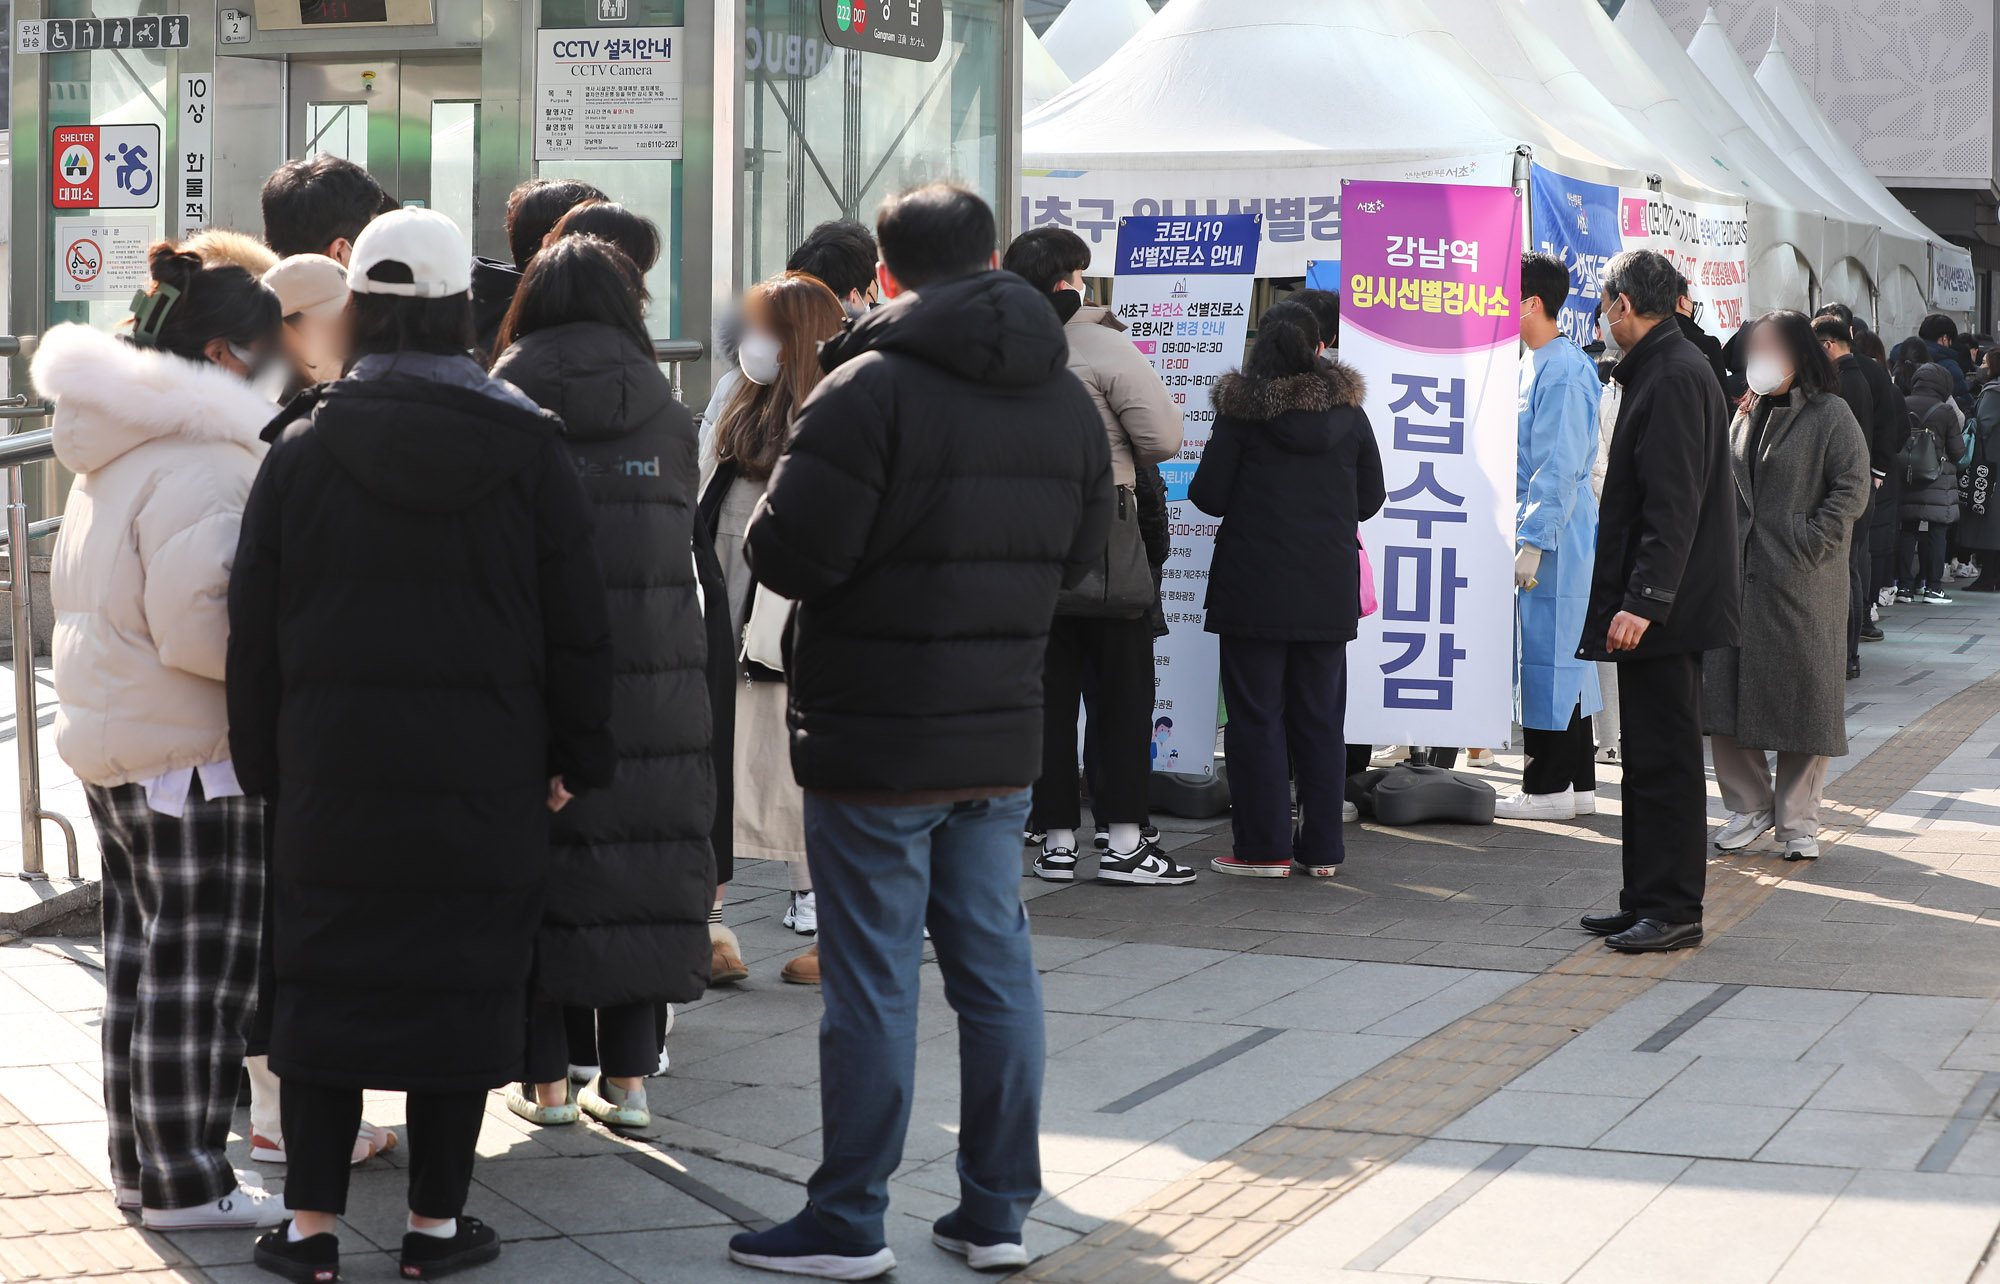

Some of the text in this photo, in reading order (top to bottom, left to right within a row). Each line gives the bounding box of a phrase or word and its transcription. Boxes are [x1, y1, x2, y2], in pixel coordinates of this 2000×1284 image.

[837, 6, 851, 21] 222
[853, 9, 866, 25] D07
[23, 25, 40, 36] 우선
[233, 23, 239, 33] 2
[23, 37, 40, 48] 탑승
[873, 28, 895, 43] Gangnam
[553, 37, 672, 60] CCTV 설치안내
[571, 64, 652, 77] CCTV Camera
[60, 133, 94, 143] SHELTER
[1445, 165, 1470, 178] 서초
[59, 187, 94, 201] 대피소
[1357, 202, 1377, 214] 서초
[1154, 221, 1224, 242] 코로나19
[1129, 245, 1244, 268] 선별진료소 안내
[1385, 235, 1480, 273] 강남역
[1350, 274, 1510, 317] 임시선별검사소
[1117, 302, 1244, 318] 서초구 보건소 선별진료소
[1131, 320, 1225, 337] 운영시간 변경 안내
[1162, 342, 1223, 354] 09:00~12:30
[1161, 358, 1189, 370] 12:00
[1379, 372, 1468, 711] 접수마감
[1168, 591, 1195, 602] 평화광장
[1166, 612, 1202, 624] 남문 주차장
